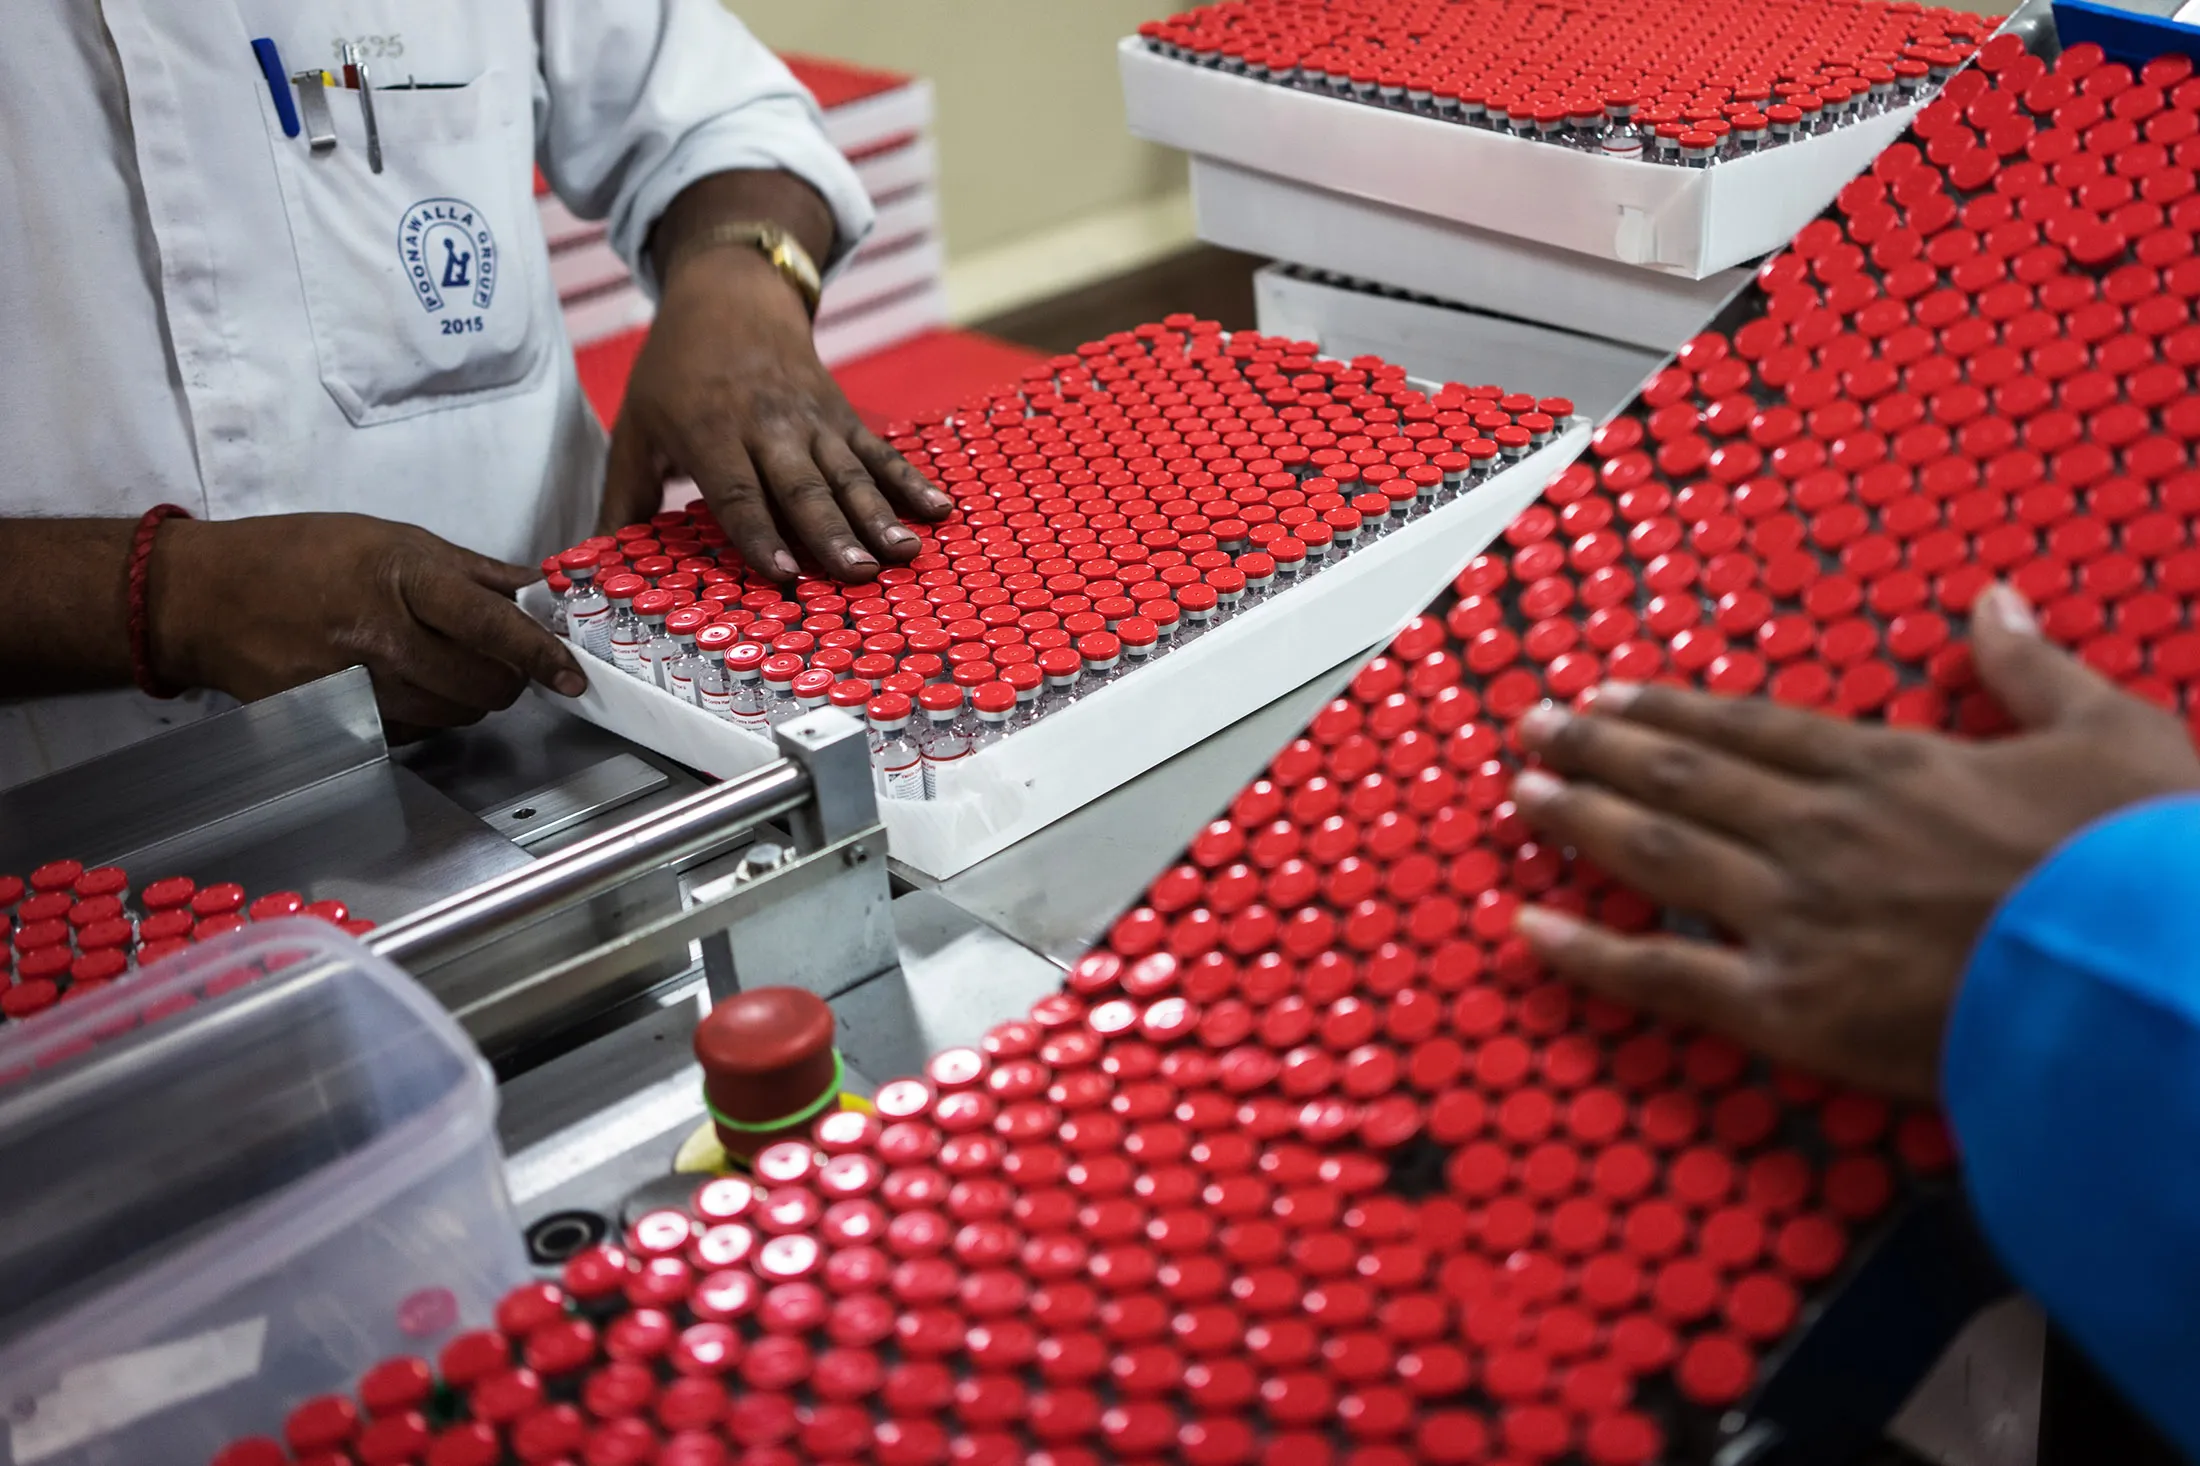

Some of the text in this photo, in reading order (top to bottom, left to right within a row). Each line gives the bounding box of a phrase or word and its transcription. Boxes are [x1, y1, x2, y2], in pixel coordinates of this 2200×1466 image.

[405, 206, 492, 307] POONAWALLA GROUP
[441, 316, 484, 335] 2015
